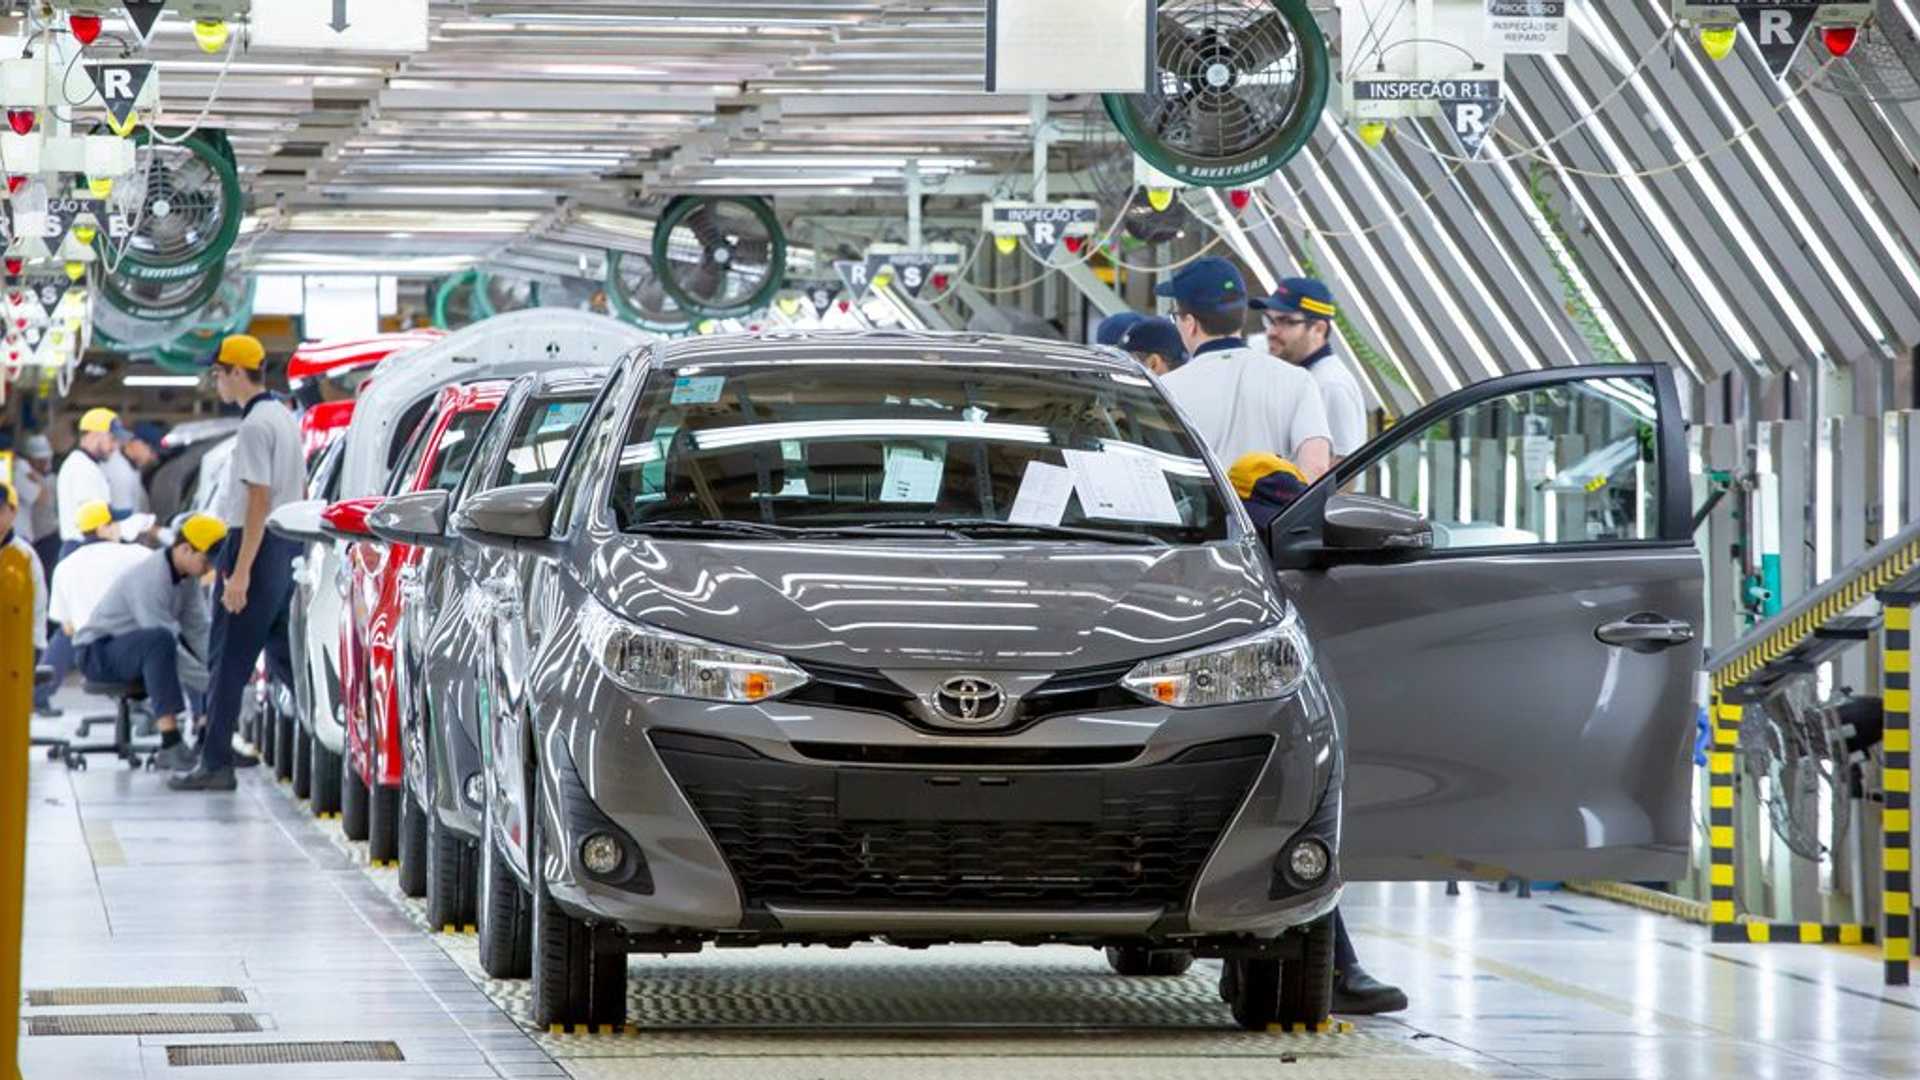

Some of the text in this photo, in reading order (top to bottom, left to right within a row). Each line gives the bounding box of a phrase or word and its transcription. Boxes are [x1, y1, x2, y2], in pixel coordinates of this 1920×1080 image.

[1760, 9, 1795, 44] R
[104, 69, 134, 99] R
[1370, 79, 1481, 99] INSPEÇÃO R1
[1456, 104, 1484, 133] R
[1034, 222, 1055, 244] R
[852, 265, 867, 285] R
[903, 266, 922, 287] S
